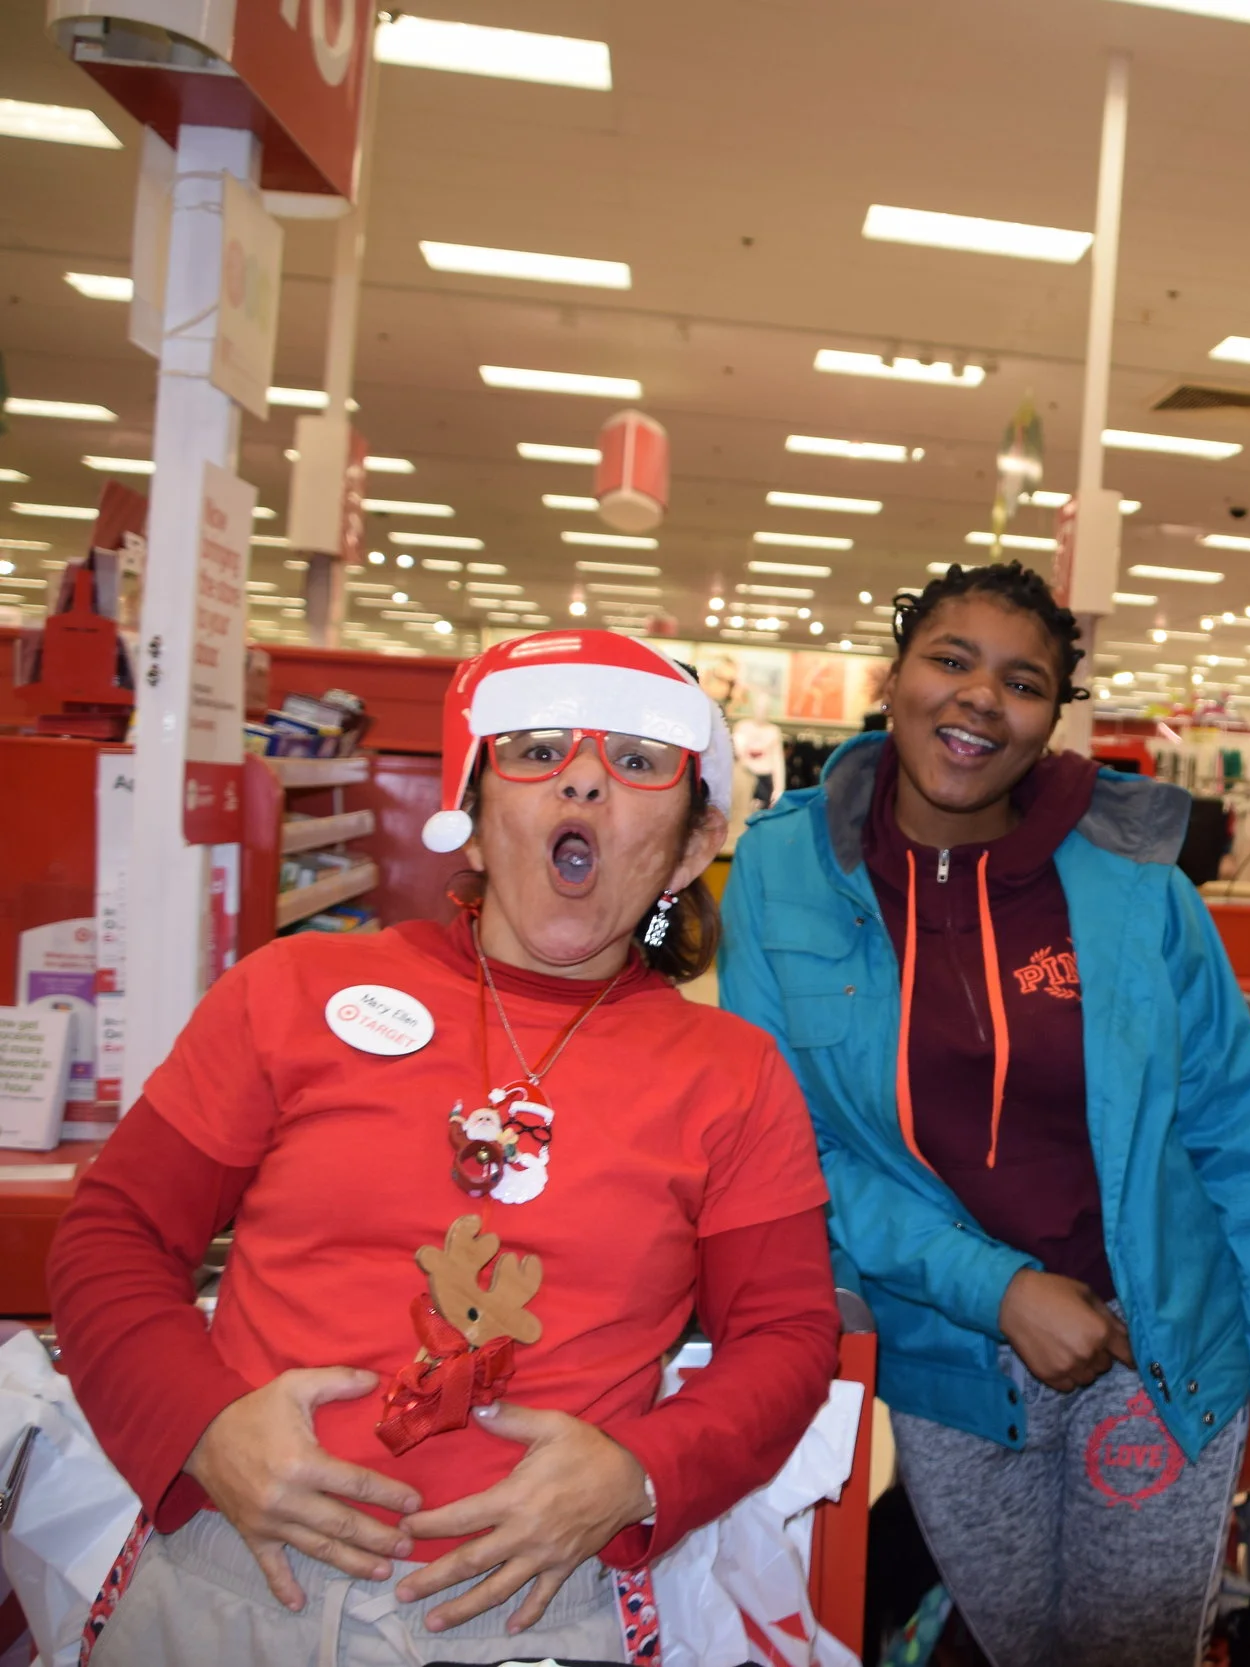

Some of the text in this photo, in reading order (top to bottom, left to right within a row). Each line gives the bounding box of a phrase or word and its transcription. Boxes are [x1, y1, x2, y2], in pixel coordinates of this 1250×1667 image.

[361, 993, 419, 1028] Mary Ellen
[359, 1016, 417, 1048] TARGET
[1104, 1445, 1163, 1468] LOVE
